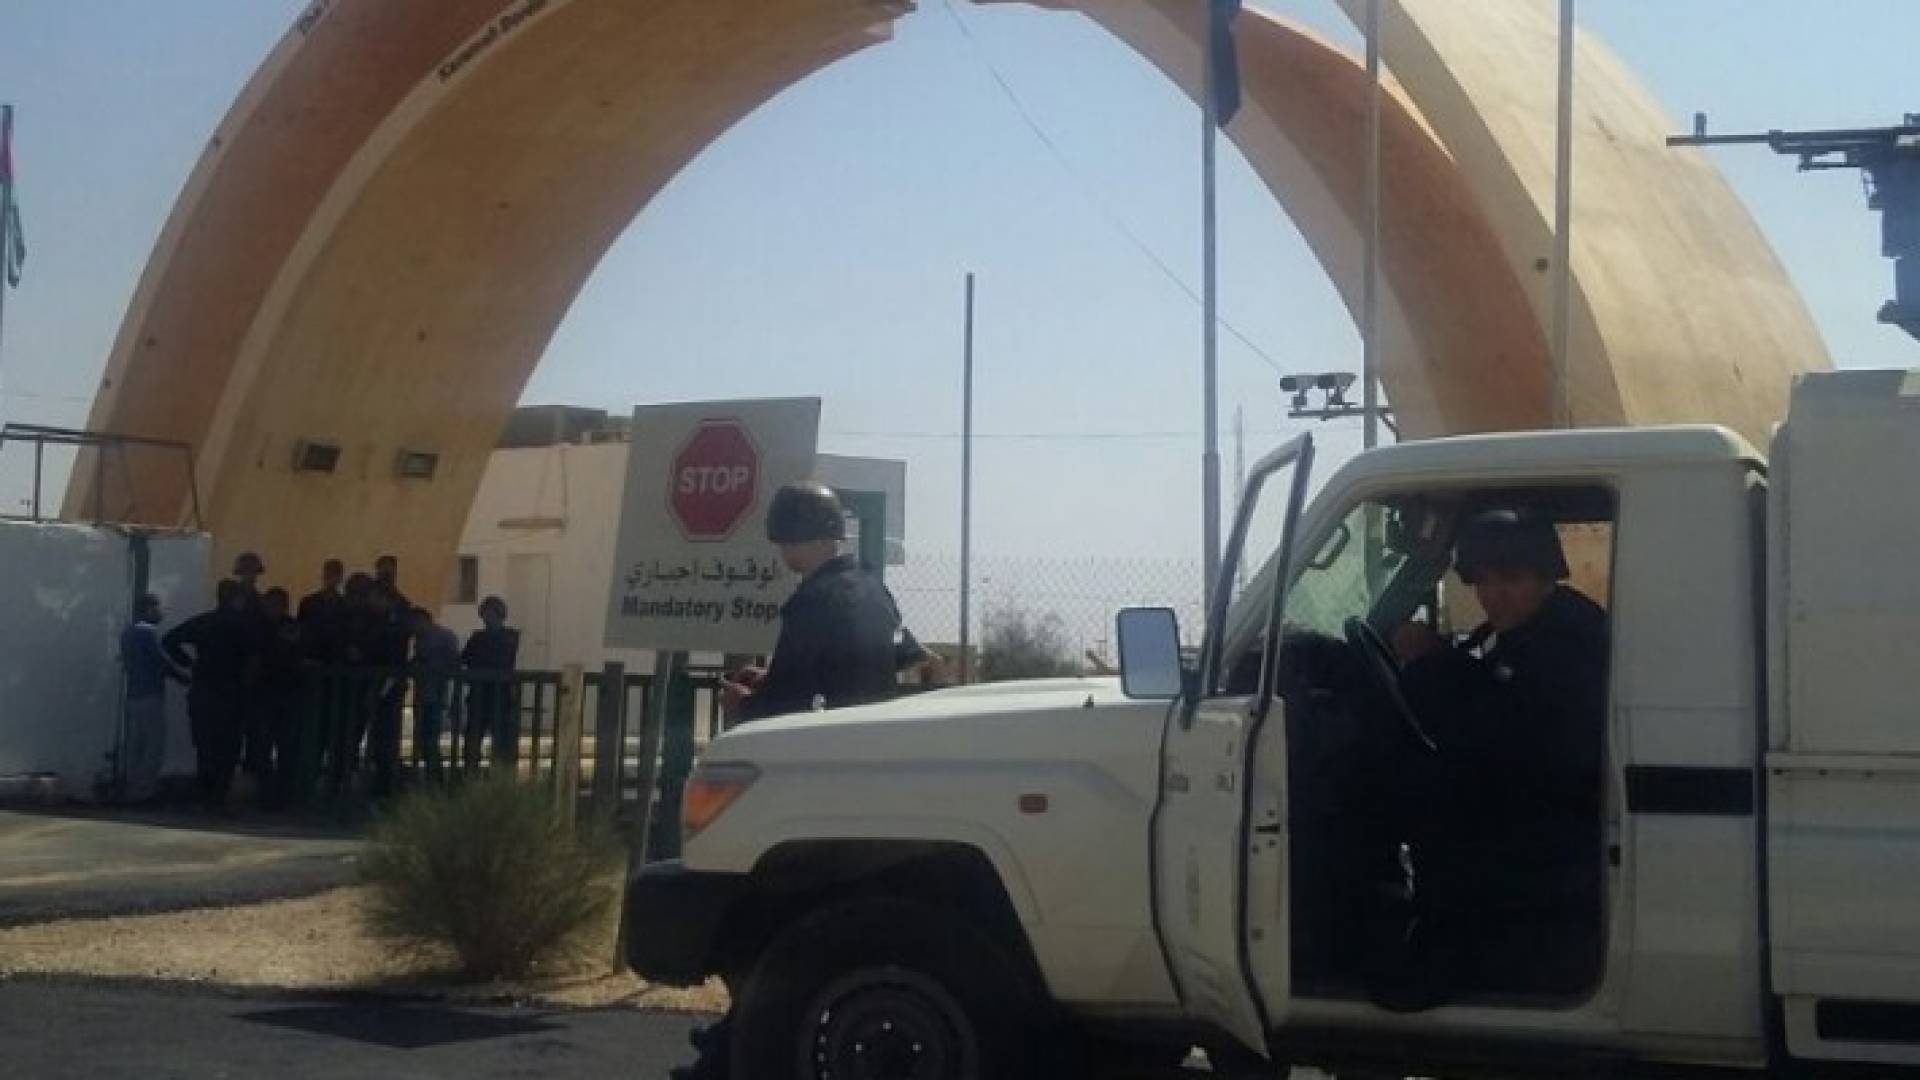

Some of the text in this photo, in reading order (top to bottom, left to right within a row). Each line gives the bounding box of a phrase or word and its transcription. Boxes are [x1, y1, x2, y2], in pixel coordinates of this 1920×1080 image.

[681, 466, 749, 494] STOP
[622, 596, 779, 624] Mandatory Stop
